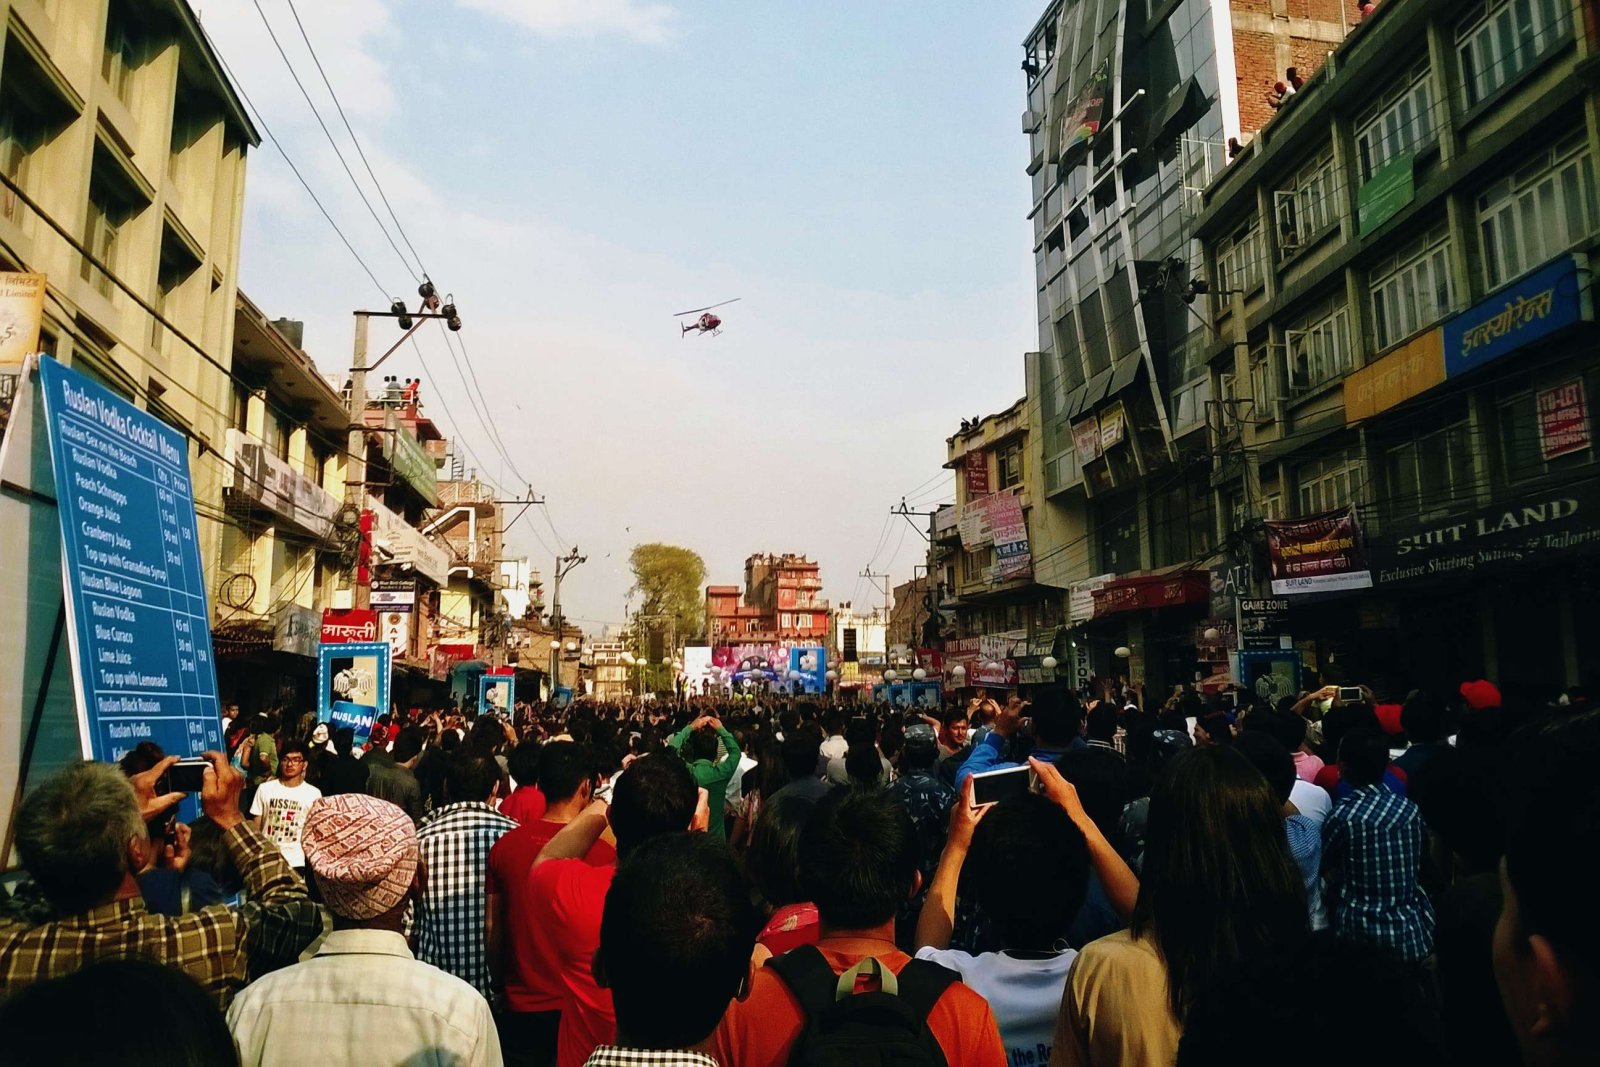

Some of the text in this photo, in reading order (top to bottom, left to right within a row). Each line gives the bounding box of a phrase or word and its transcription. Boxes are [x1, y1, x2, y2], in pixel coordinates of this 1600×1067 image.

[6, 289, 37, 297] Limited
[62, 379, 180, 465] Ruslan Vodka Cocktail Menu
[61, 419, 137, 468] Ruslan Sex on the Beach
[72, 448, 117, 479] Ruslan Vodka
[158, 468, 169, 485] Qty.
[174, 476, 186, 492] Price
[76, 472, 127, 506] Peach Schnapps
[159, 489, 173, 504] 60 ml
[78, 496, 120, 523] Orange Juice
[162, 510, 176, 525] 15 ml
[182, 527, 191, 540] 150
[1397, 498, 1579, 556] SUIT LAND
[82, 522, 131, 550] Cranberry Juice
[164, 530, 178, 545] 90 ml
[1019, 542, 1028, 550] +2
[84, 545, 166, 582] Top up with Granadine Syrup
[167, 550, 180, 566] 30 ml
[1380, 564, 1425, 583] Exclusive
[1428, 553, 1475, 570] Shirting
[81, 571, 142, 600] Ruslan Blue Lagoon
[92, 601, 136, 622] Ruslan Vodka
[1242, 600, 1288, 611] GAME ZONE
[176, 619, 190, 632] 45 ml
[322, 621, 376, 639] मारूती
[95, 624, 134, 644] Blue Curaco
[178, 638, 192, 652] 30 ml
[98, 647, 132, 664] Lime Juice
[198, 650, 207, 662] 150
[180, 658, 194, 672] 30 ml
[100, 669, 168, 688] Top up with Lemonade
[98, 697, 160, 712] Ruslan Black Russian
[189, 721, 202, 734] 60 ml
[332, 711, 373, 728] RUSLAN
[109, 722, 151, 738] Ruslan Vodka
[208, 730, 218, 743] 150
[192, 738, 204, 752] 60 ml
[270, 798, 289, 810] KISS
[1012, 1048, 1034, 1066] the
